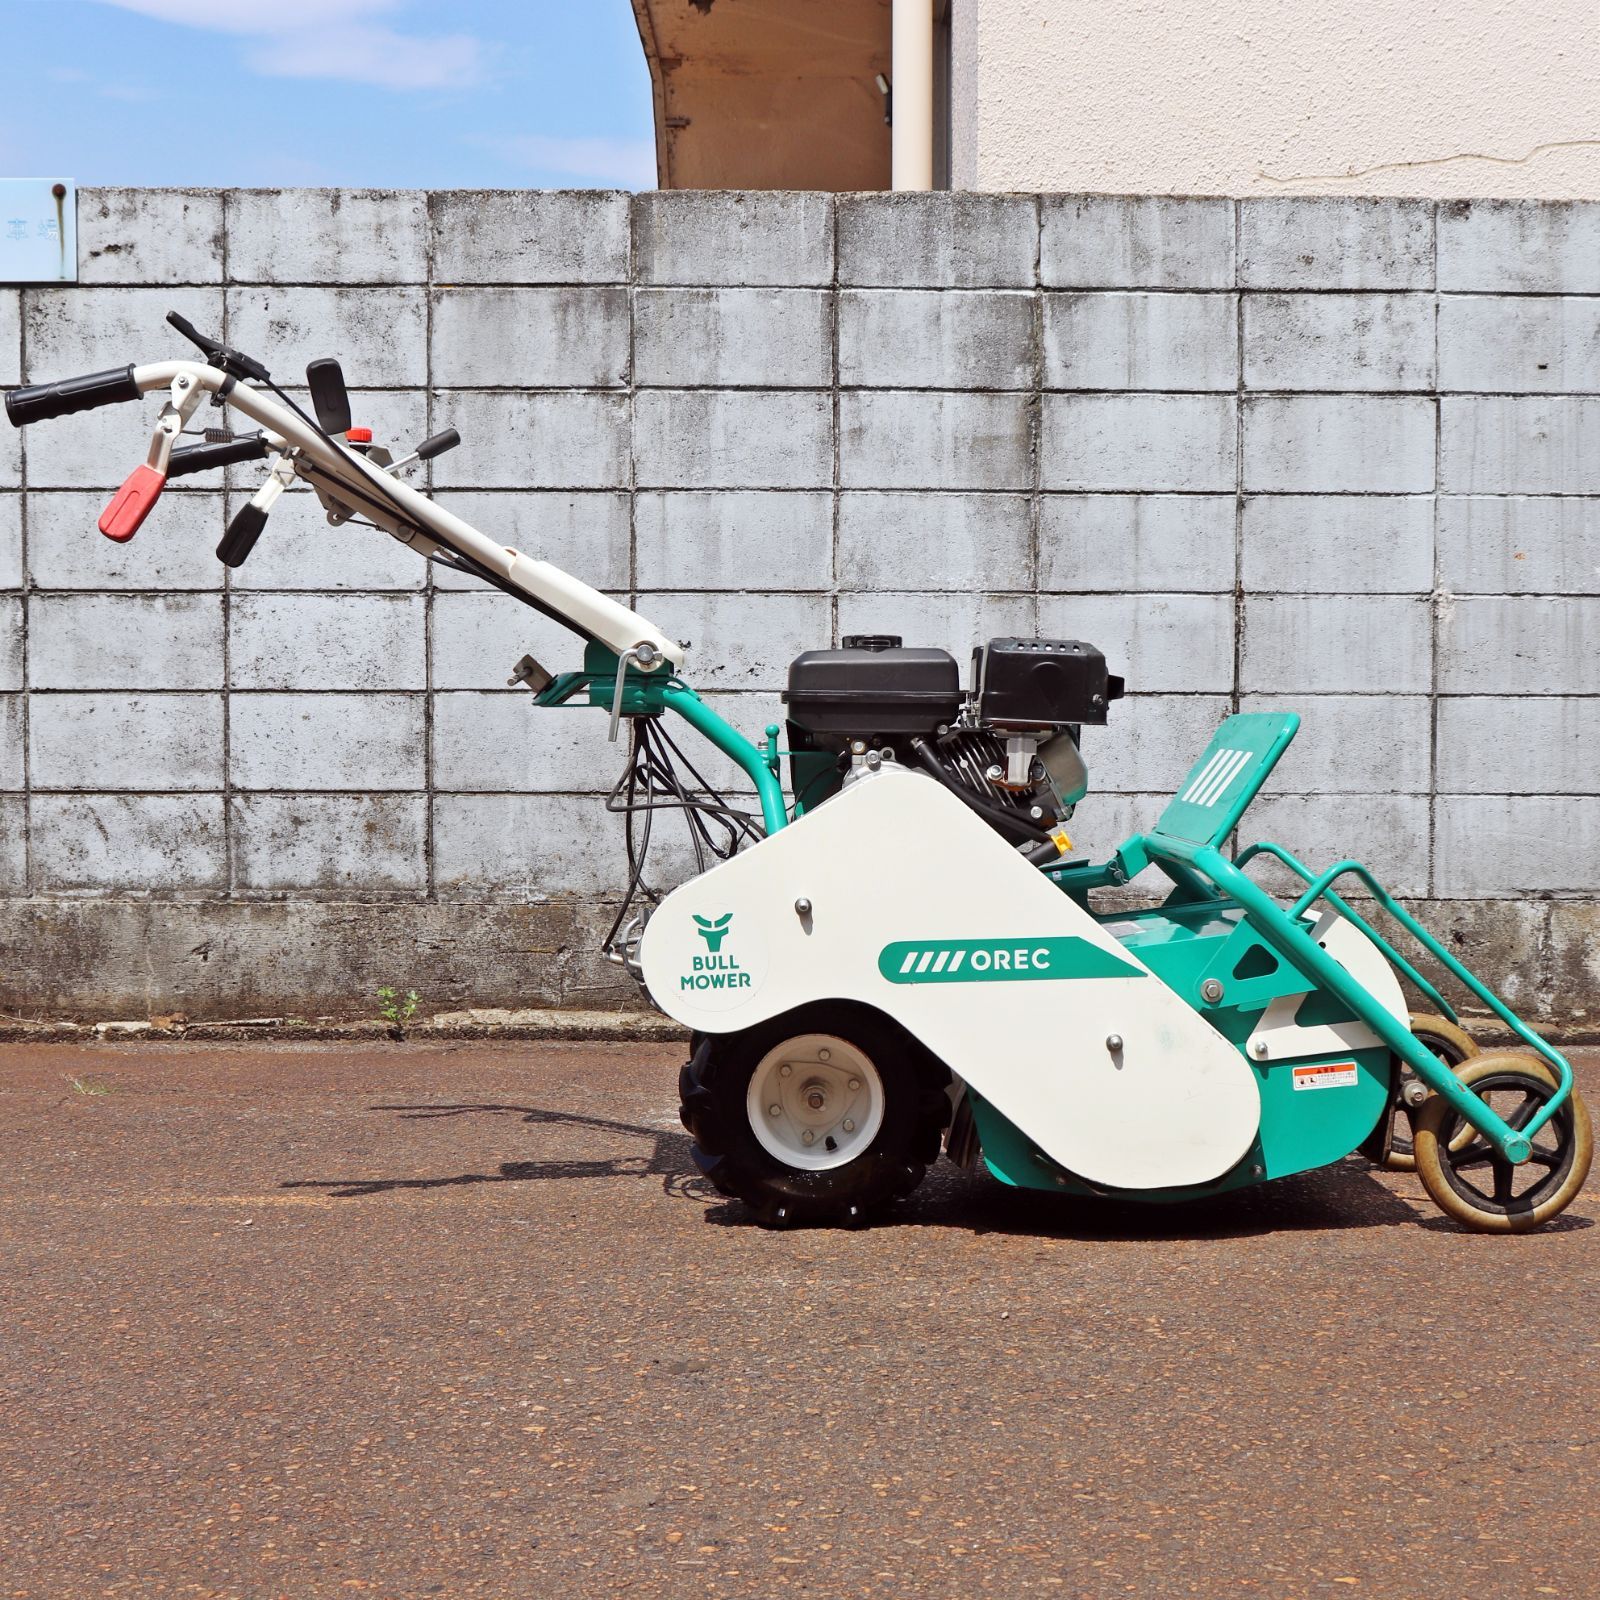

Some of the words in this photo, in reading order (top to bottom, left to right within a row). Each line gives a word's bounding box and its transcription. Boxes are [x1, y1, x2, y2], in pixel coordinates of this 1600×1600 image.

[692, 955, 740, 971] BULL
[970, 948, 1050, 971] OREC
[680, 972, 752, 991] MOWER
